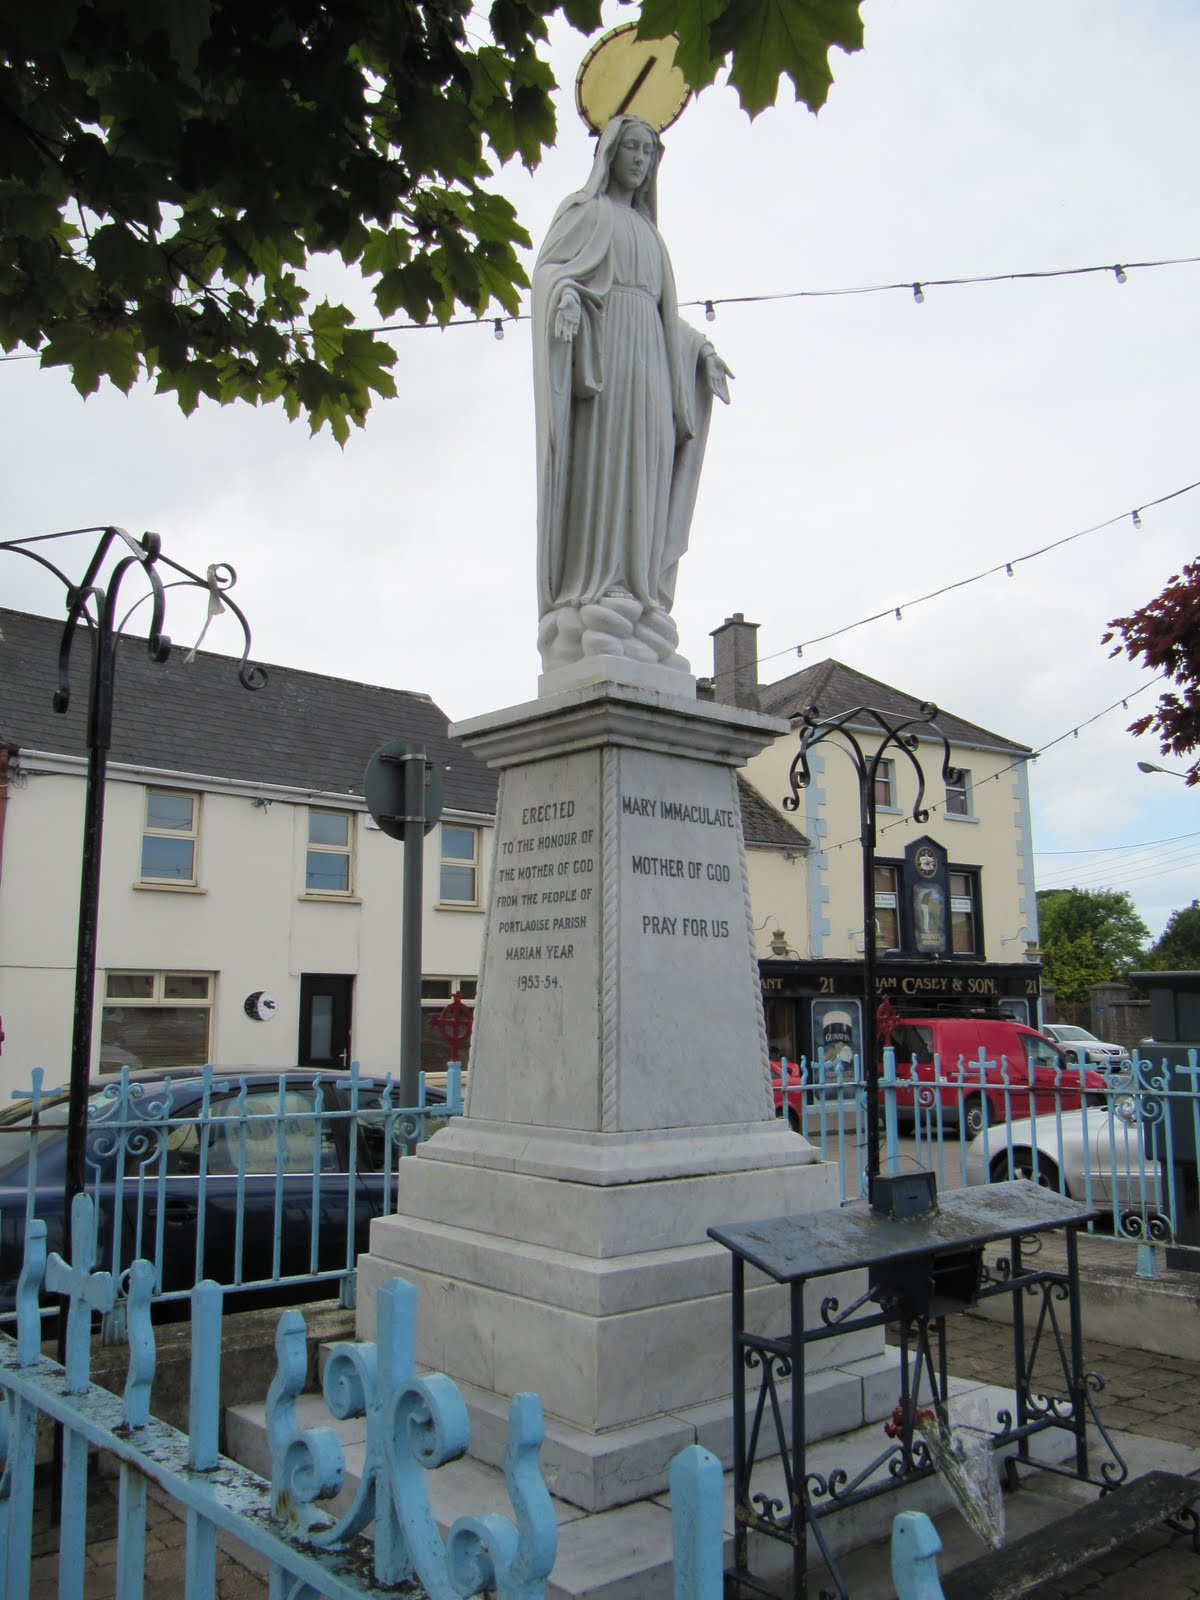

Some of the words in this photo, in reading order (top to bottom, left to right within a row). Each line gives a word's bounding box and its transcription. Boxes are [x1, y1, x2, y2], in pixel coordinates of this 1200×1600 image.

[522, 800, 575, 825] ERECTED
[622, 796, 657, 818] MARY
[660, 801, 734, 828] IMMACULATE
[503, 842, 513, 855] TO
[518, 839, 535, 853] THE
[538, 832, 577, 851] HONOUR
[582, 829, 594, 844] OF
[499, 869, 515, 882] THE
[518, 863, 554, 880] MOTHER
[558, 861, 569, 875] OF
[573, 859, 594, 874] GOD
[632, 855, 685, 878] MOTHER
[688, 861, 702, 879] OF
[707, 864, 730, 882] GOD
[497, 895, 518, 908] FROM
[522, 893, 538, 905] THE
[542, 889, 577, 904] PEOPLE
[581, 888, 592, 901] OF
[499, 918, 550, 934] PORTLAOISE
[553, 916, 587, 930] PARISH
[642, 915, 677, 936] PRAY
[683, 918, 708, 937] FOR
[712, 920, 729, 938] US
[505, 946, 541, 961] MARIAN
[546, 944, 574, 960] YEAR
[760, 978, 783, 990] ANT
[820, 977, 836, 993] 21
[901, 977, 948, 995] CASEY
[952, 979, 962, 991] &
[1025, 979, 1038, 994] 21
